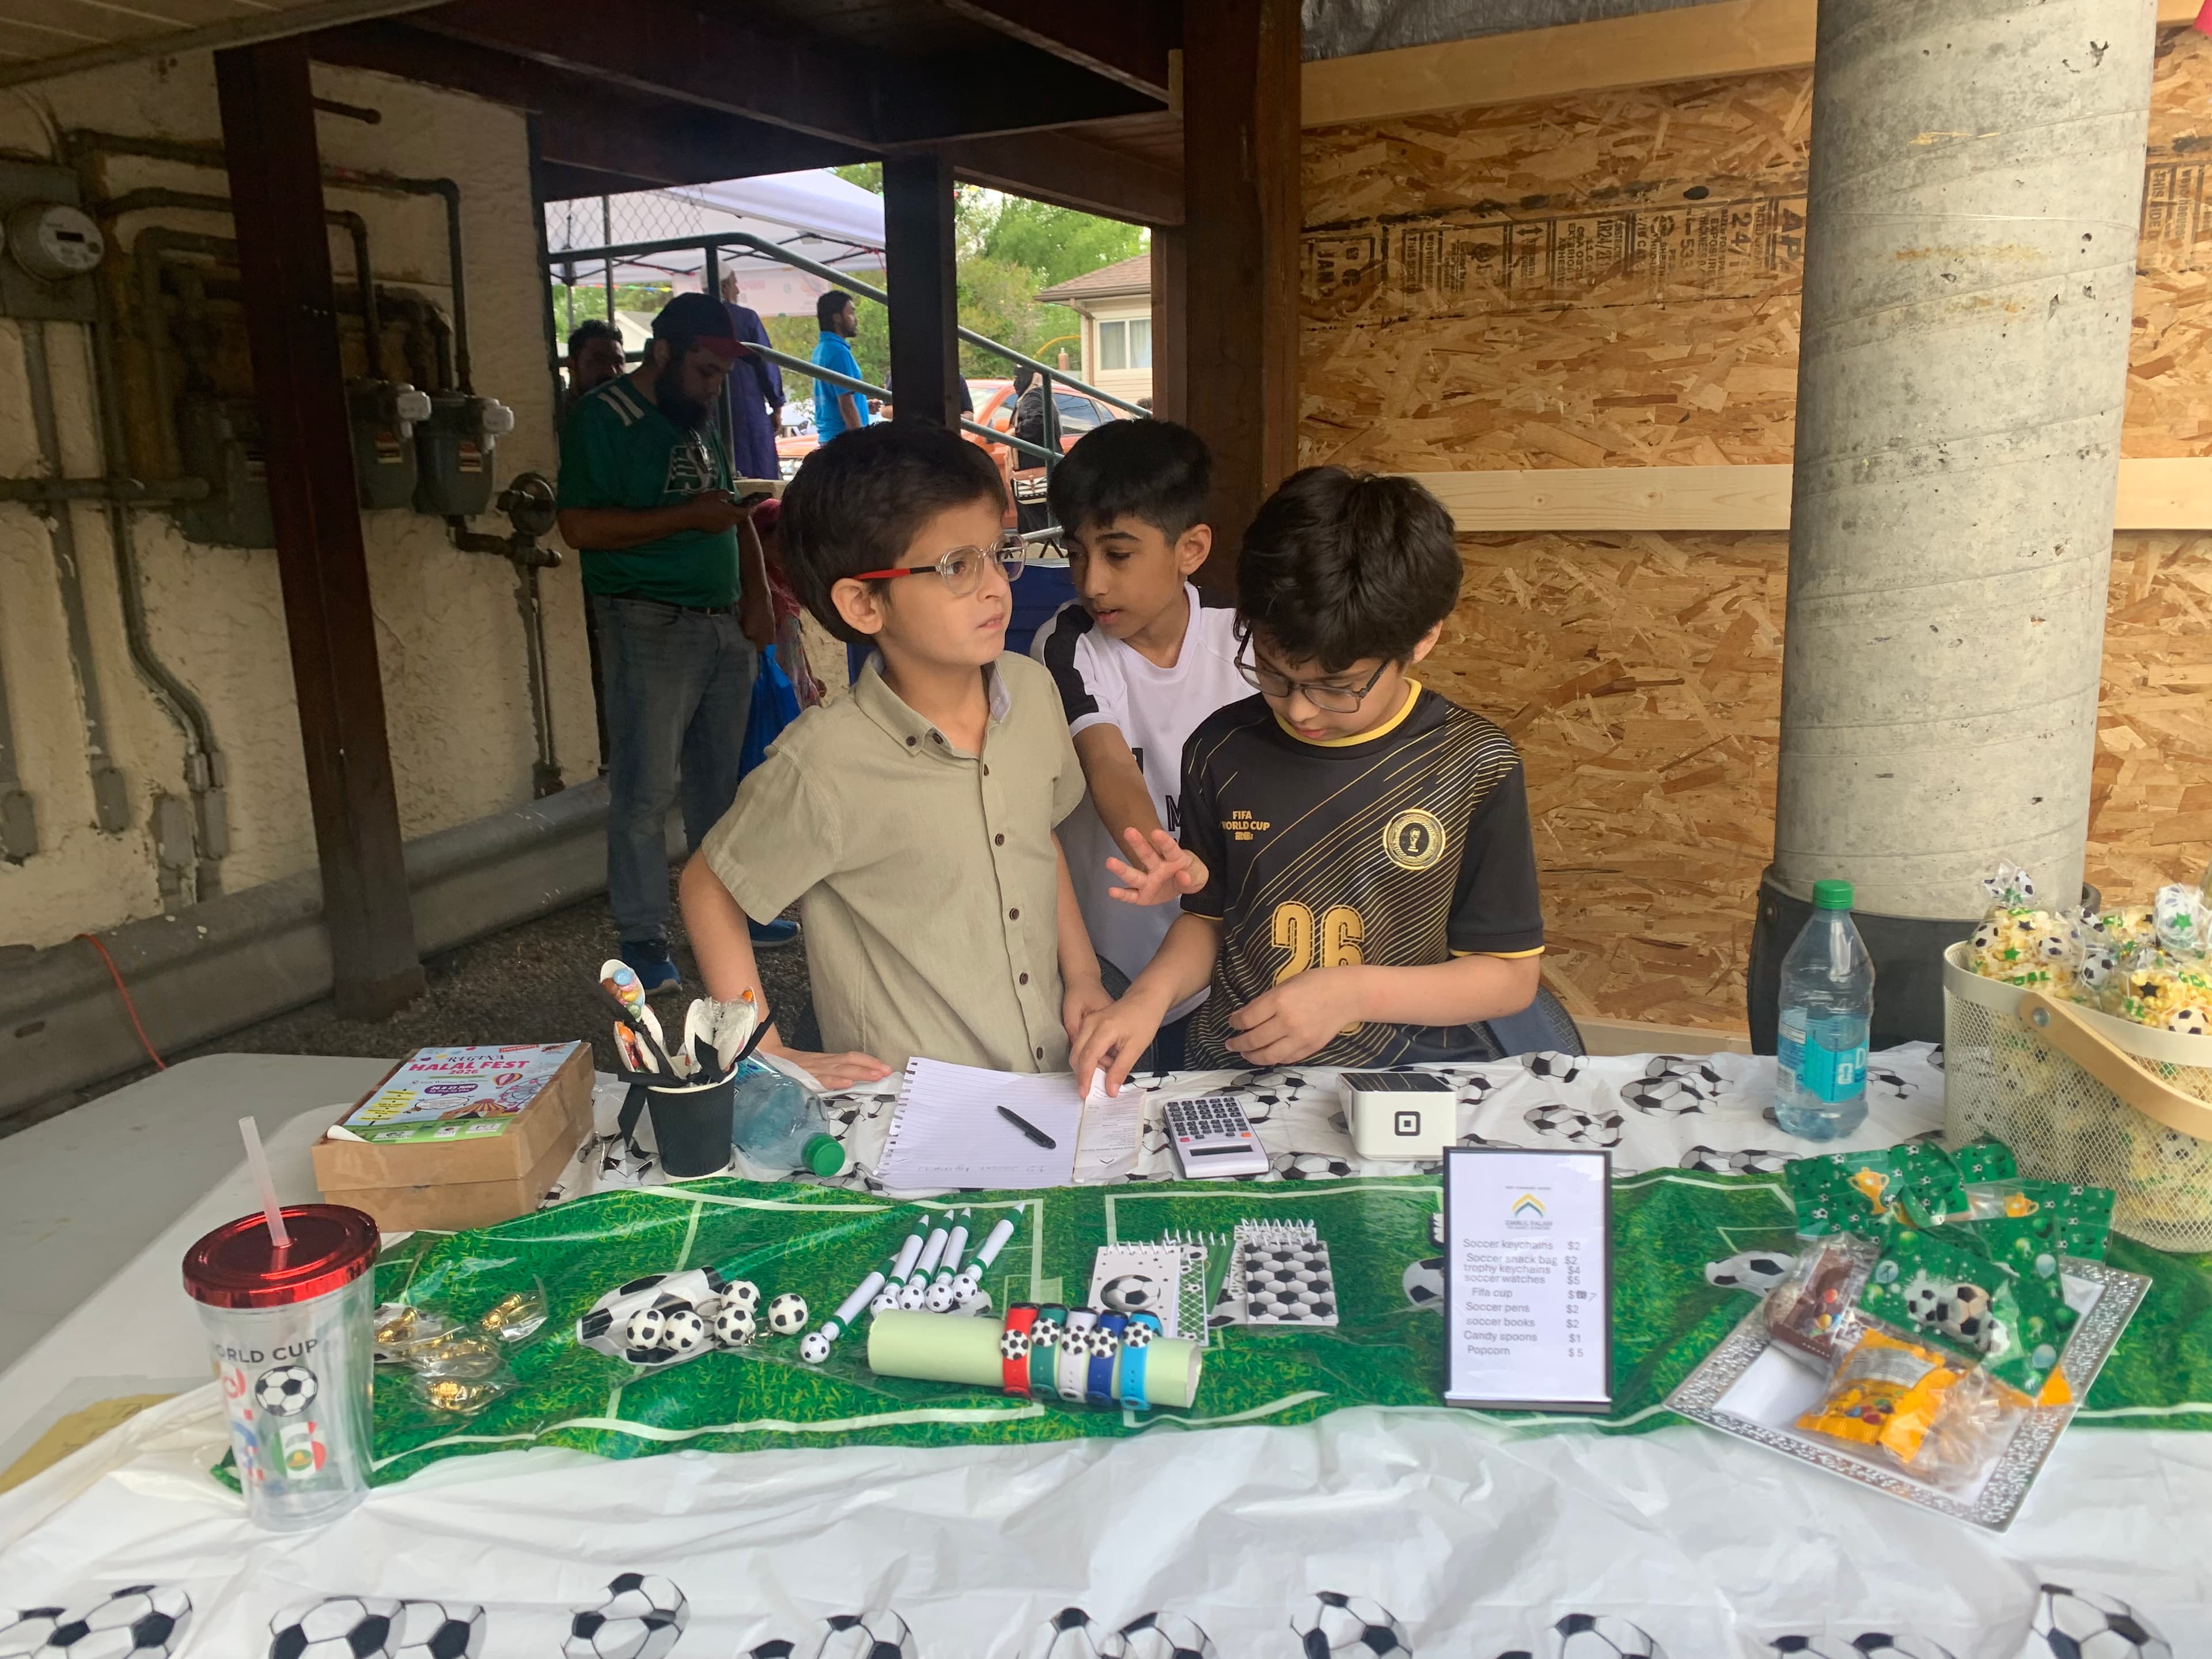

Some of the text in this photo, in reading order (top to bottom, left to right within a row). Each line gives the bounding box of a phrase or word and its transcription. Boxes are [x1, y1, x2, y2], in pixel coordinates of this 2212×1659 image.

[1577, 226, 1585, 248] CSA
[1232, 810, 1252, 820] FIFA
[1250, 821, 1270, 831] CUP
[409, 1062, 474, 1071] HALAL
[1463, 1239, 1581, 1251] Soccer keychains $2
[1467, 1253, 1577, 1267] Soccer snack bag $2
[1464, 1264, 1497, 1274] trophy
[1499, 1265, 1551, 1275] keychains
[1465, 1274, 1581, 1285] soccer watches $5
[1493, 1290, 1512, 1298] cup
[1465, 1302, 1579, 1314] Soccer pens $2
[1467, 1317, 1579, 1328] soccer books $2
[1464, 1331, 1581, 1343] Candy spoons $1
[214, 1339, 318, 1363] ORLD CUP
[1467, 1345, 1510, 1355] Popcorn
